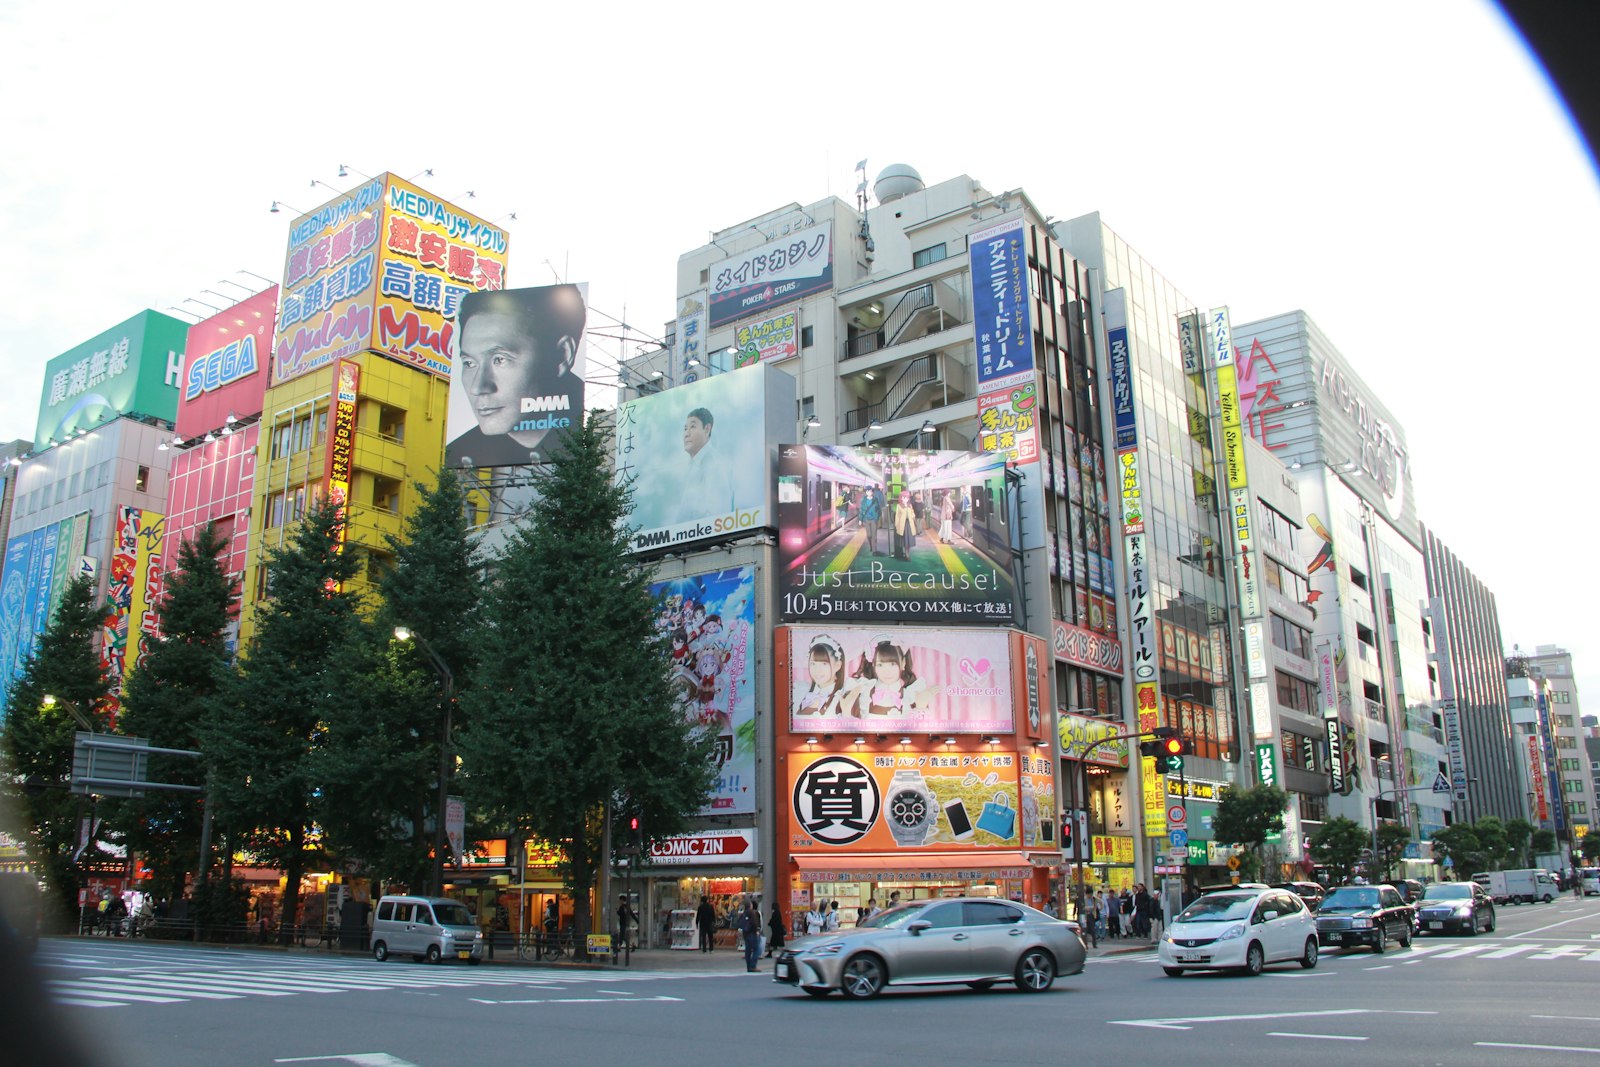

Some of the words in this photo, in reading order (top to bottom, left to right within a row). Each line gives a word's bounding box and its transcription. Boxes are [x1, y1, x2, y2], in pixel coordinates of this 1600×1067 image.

[290, 179, 382, 250] MEDIAリサイクル
[389, 185, 507, 254] MEDIAリサイクル
[972, 229, 997, 241] AMENITY
[1000, 220, 1021, 232] DREAM
[715, 233, 826, 292] メイドカジノ
[742, 293, 764, 308] POKER
[773, 281, 796, 297] STARS
[988, 238, 1014, 372] アメニティードリーム
[388, 343, 428, 365] ムーラン
[981, 332, 993, 376] 秋葉原店
[186, 334, 260, 402] SEGA
[338, 402, 354, 413] DVD
[520, 394, 570, 413] DMM
[1221, 391, 1233, 424] Yellow
[981, 405, 1034, 432] まんが
[337, 428, 350, 438] CD
[1225, 430, 1239, 483] Submarine
[1121, 452, 1137, 490] まんが
[714, 508, 760, 533] solar
[636, 529, 671, 549] DMM
[797, 564, 857, 589] Just
[871, 561, 998, 591] Because!
[865, 600, 921, 613] TOKYO
[1054, 625, 1121, 670] メイドカジノ
[946, 686, 983, 697] @home
[875, 756, 895, 768] 時計
[898, 756, 927, 767] バッグ
[930, 756, 960, 768] 貴金属
[962, 756, 990, 767] ダイヤ
[993, 755, 1013, 767] 携帯
[1327, 720, 1343, 790] GALLERIA
[804, 770, 868, 834] 質
[1172, 810, 1182, 819] 40
[651, 838, 699, 856] COMIC
[702, 838, 724, 855] ZIN
